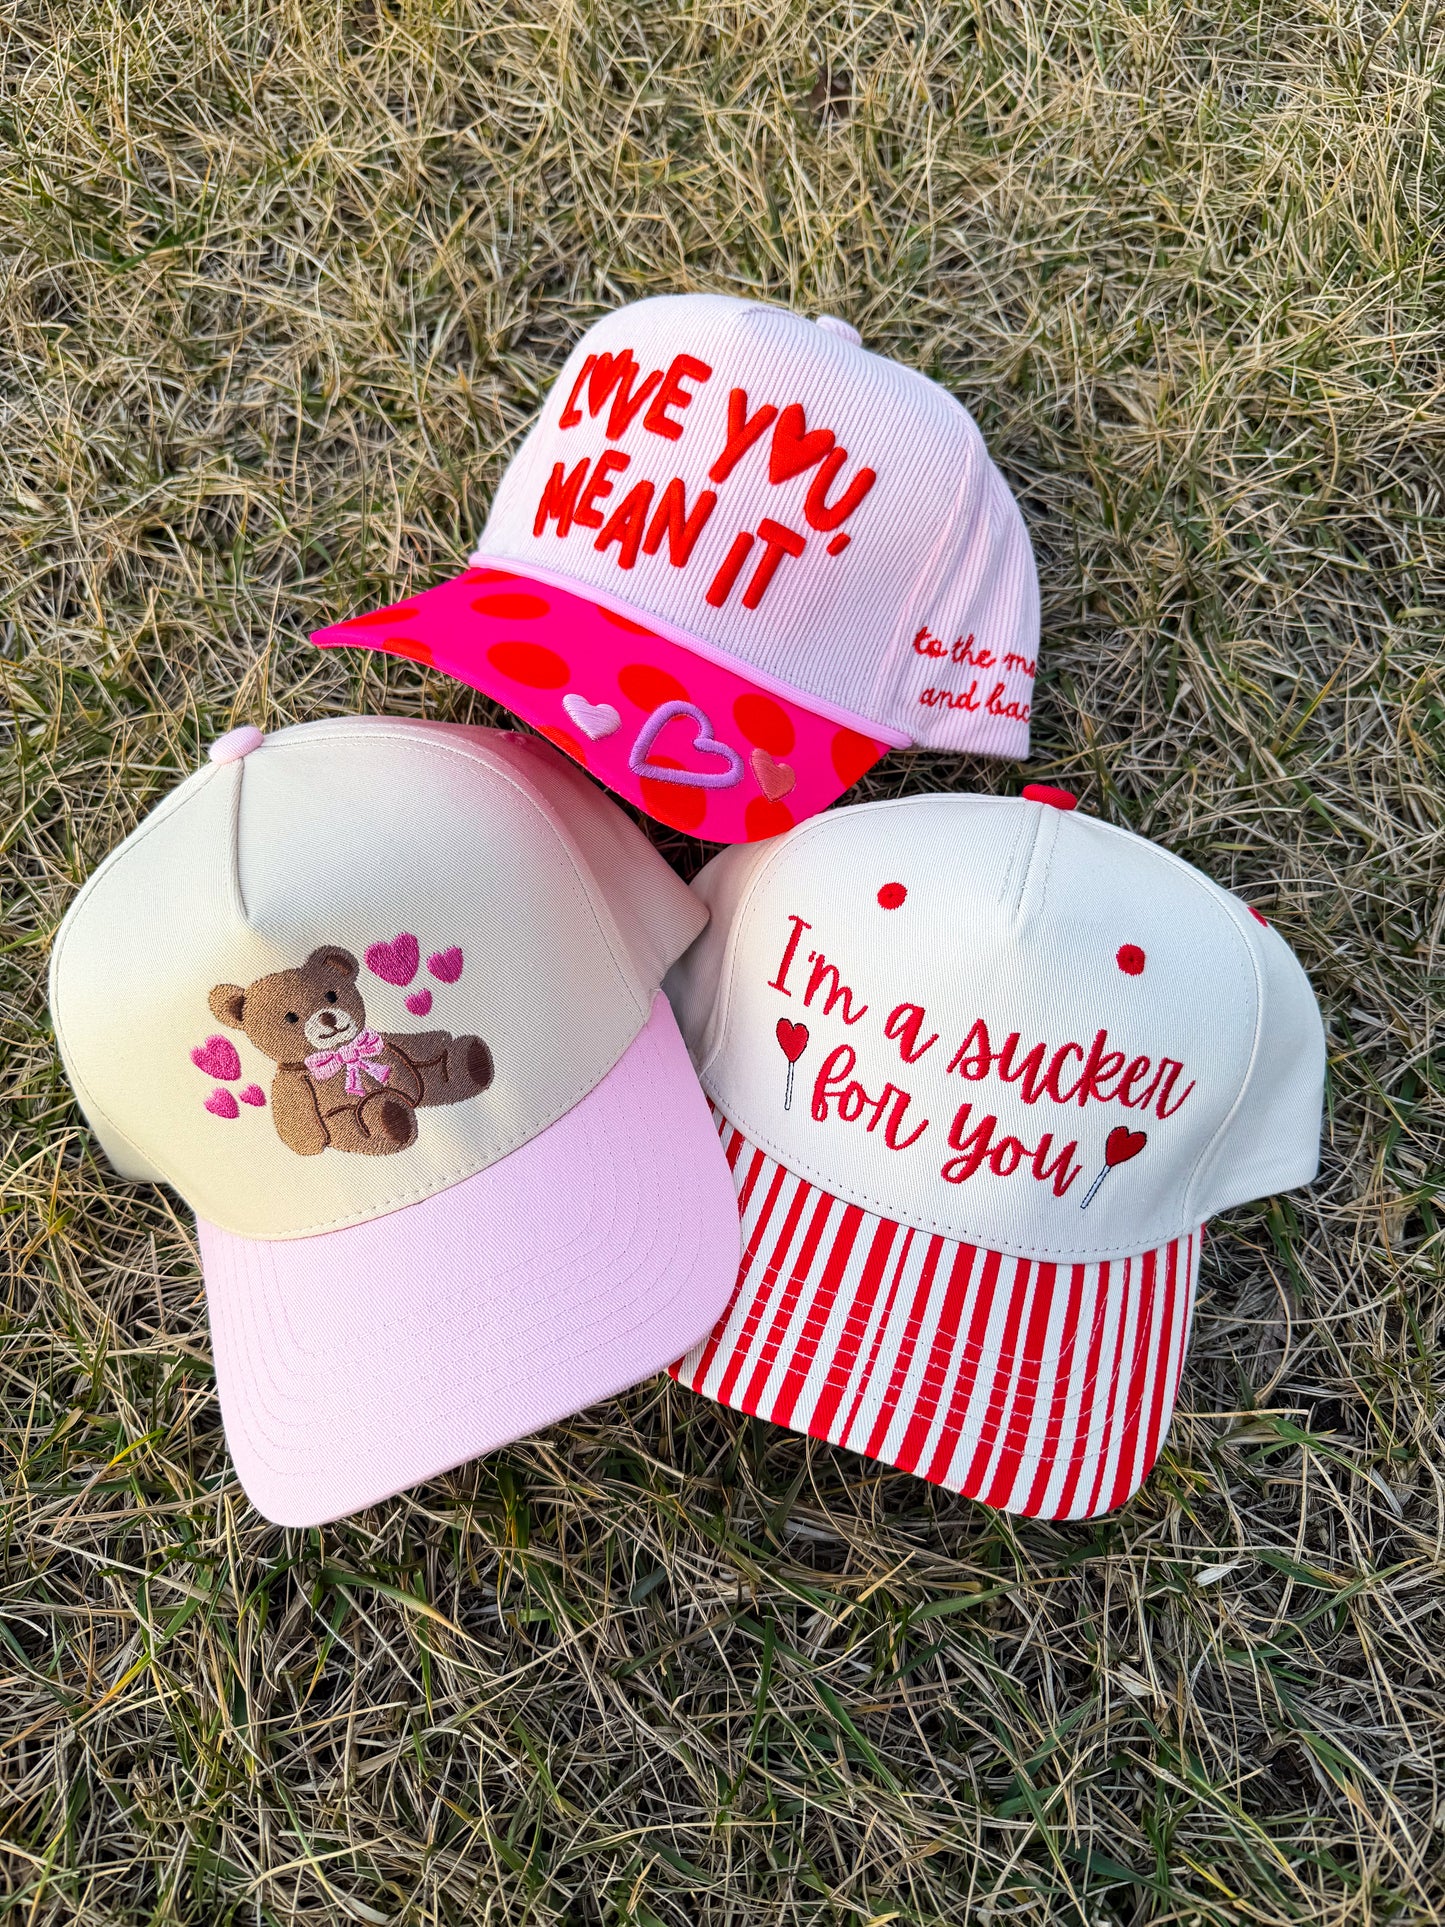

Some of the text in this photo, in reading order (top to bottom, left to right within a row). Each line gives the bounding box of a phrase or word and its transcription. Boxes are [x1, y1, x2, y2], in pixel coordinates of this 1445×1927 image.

[533, 449, 806, 610] MEAN IT
[912, 626, 948, 658] to
[952, 633, 996, 669] the
[919, 681, 980, 712] and
[767, 915, 1196, 1120] I'm a sucker
[811, 1044, 1083, 1197] for you
